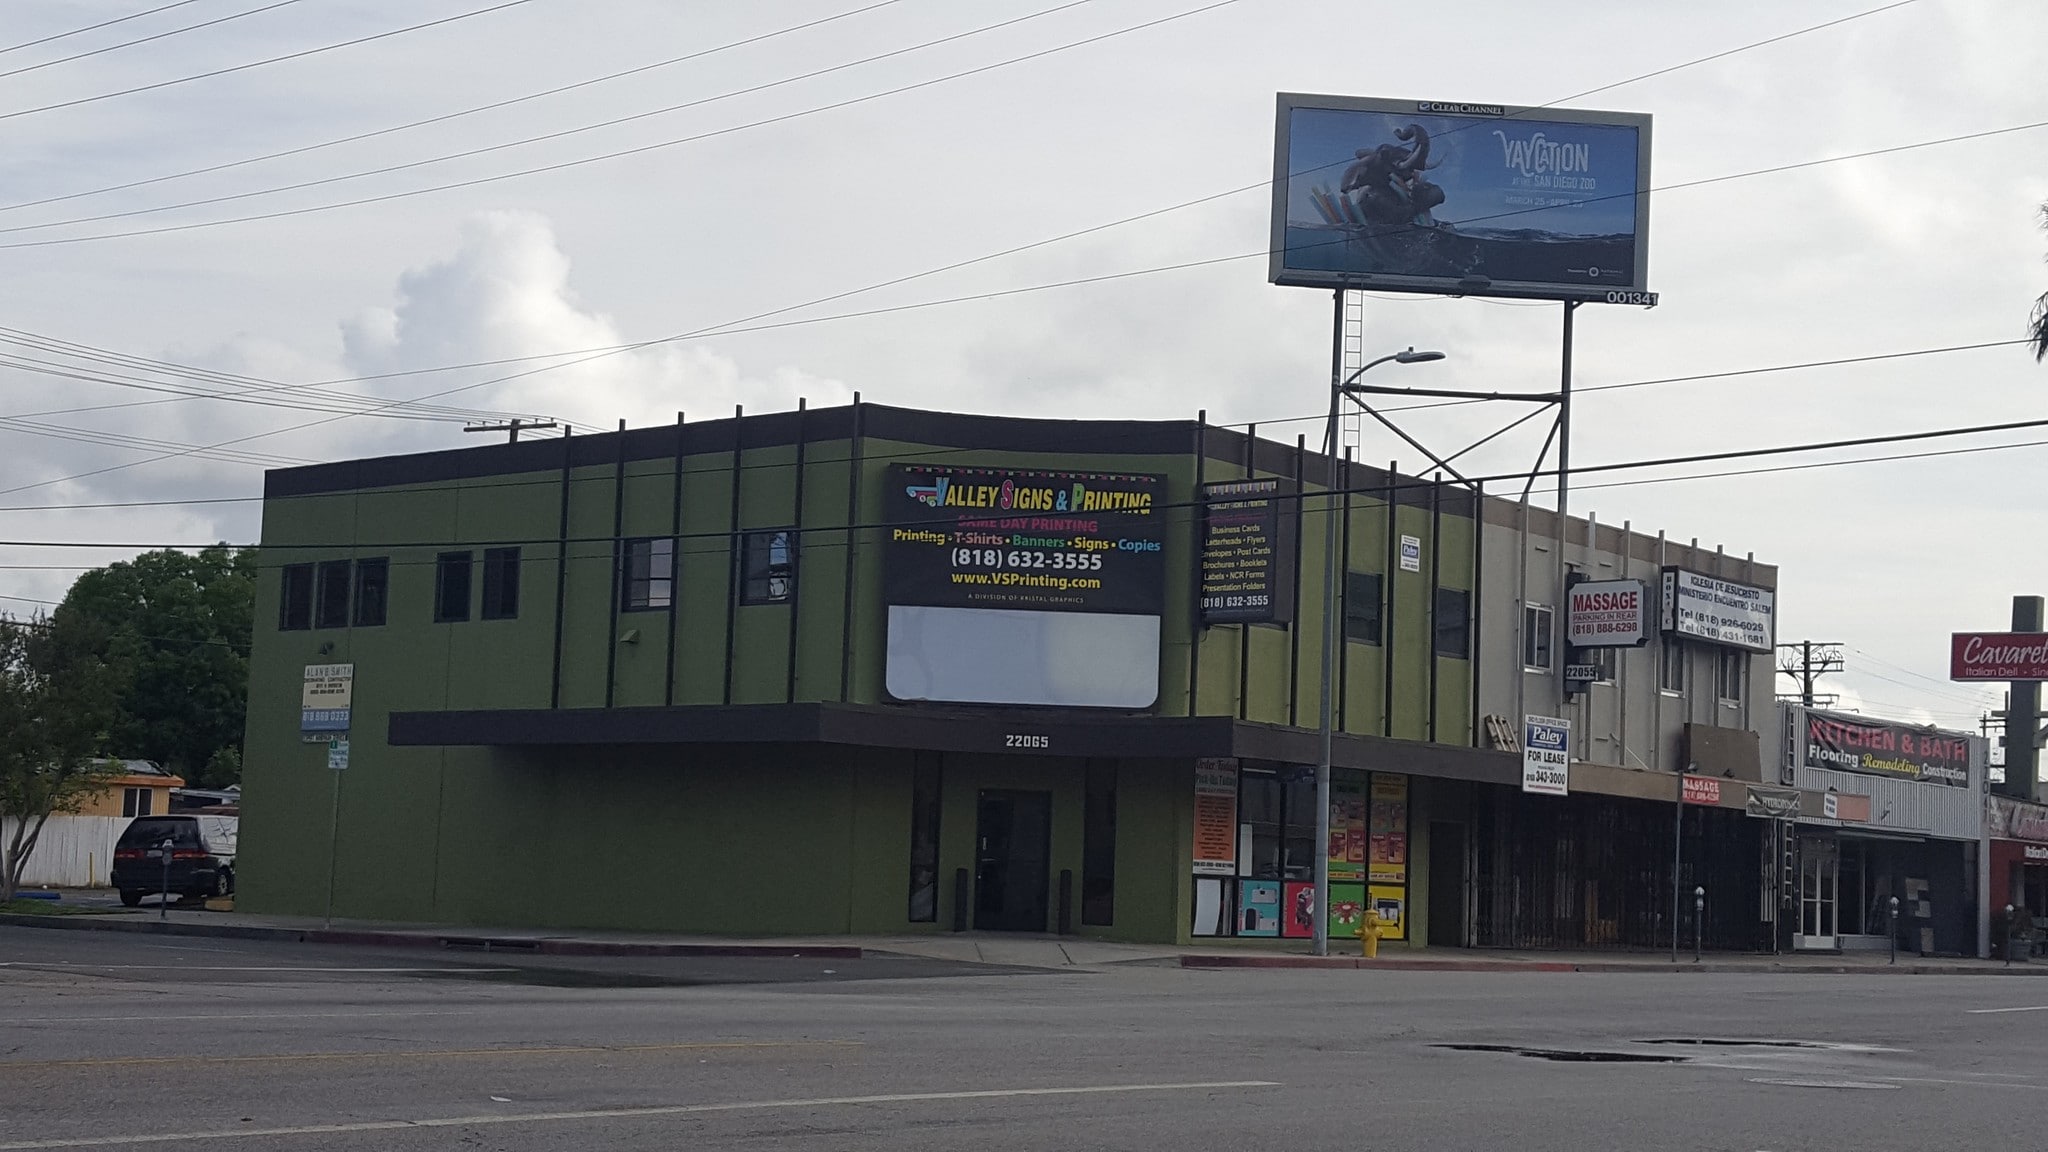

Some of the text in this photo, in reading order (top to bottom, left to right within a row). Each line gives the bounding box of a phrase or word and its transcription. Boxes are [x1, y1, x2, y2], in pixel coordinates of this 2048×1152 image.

[1535, 175, 1550, 187] SAN
[1554, 176, 1578, 189] DIEGO
[1580, 178, 1595, 189] ZOO
[1607, 291, 1657, 305] 001341
[936, 476, 1152, 515] VALLEY SIGNS & PRINTING
[957, 515, 1098, 532] SAME DAY PRINTING
[893, 529, 1161, 554] Printing T-Shirts Banners Signs Copies
[951, 549, 1102, 570] (818) 632-3555
[952, 573, 1101, 590] www.VSPrinting.com
[1203, 582, 1265, 592] Presentation Folders
[1690, 576, 1760, 600] IGLESIA DE JESUCRISTO
[1200, 595, 1268, 608] (818) 632-3555
[1573, 591, 1637, 612] MASSAGE
[1679, 586, 1771, 615] MINISTERIO ENCUENTRO SALEM
[1573, 611, 1637, 621] PARKING IN REAR
[1680, 608, 1693, 619] Tel
[1695, 612, 1719, 627] (818)
[1573, 621, 1638, 636] (818) 888-6298
[1680, 621, 1694, 632] Tel
[1696, 622, 1720, 639] (818)
[1567, 667, 1595, 677] 22055
[1965, 666, 1997, 676] Italian
[1998, 667, 2018, 676] Deli
[1533, 726, 1563, 744] Paley
[1810, 719, 1965, 762] KITCHEN & BATH
[1528, 750, 1565, 765] FOR LEASE
[1809, 744, 1966, 780] Flooring Remodeling Construction
[1536, 770, 1565, 785] 343-3000
[1683, 778, 1719, 793] MASSAGE
